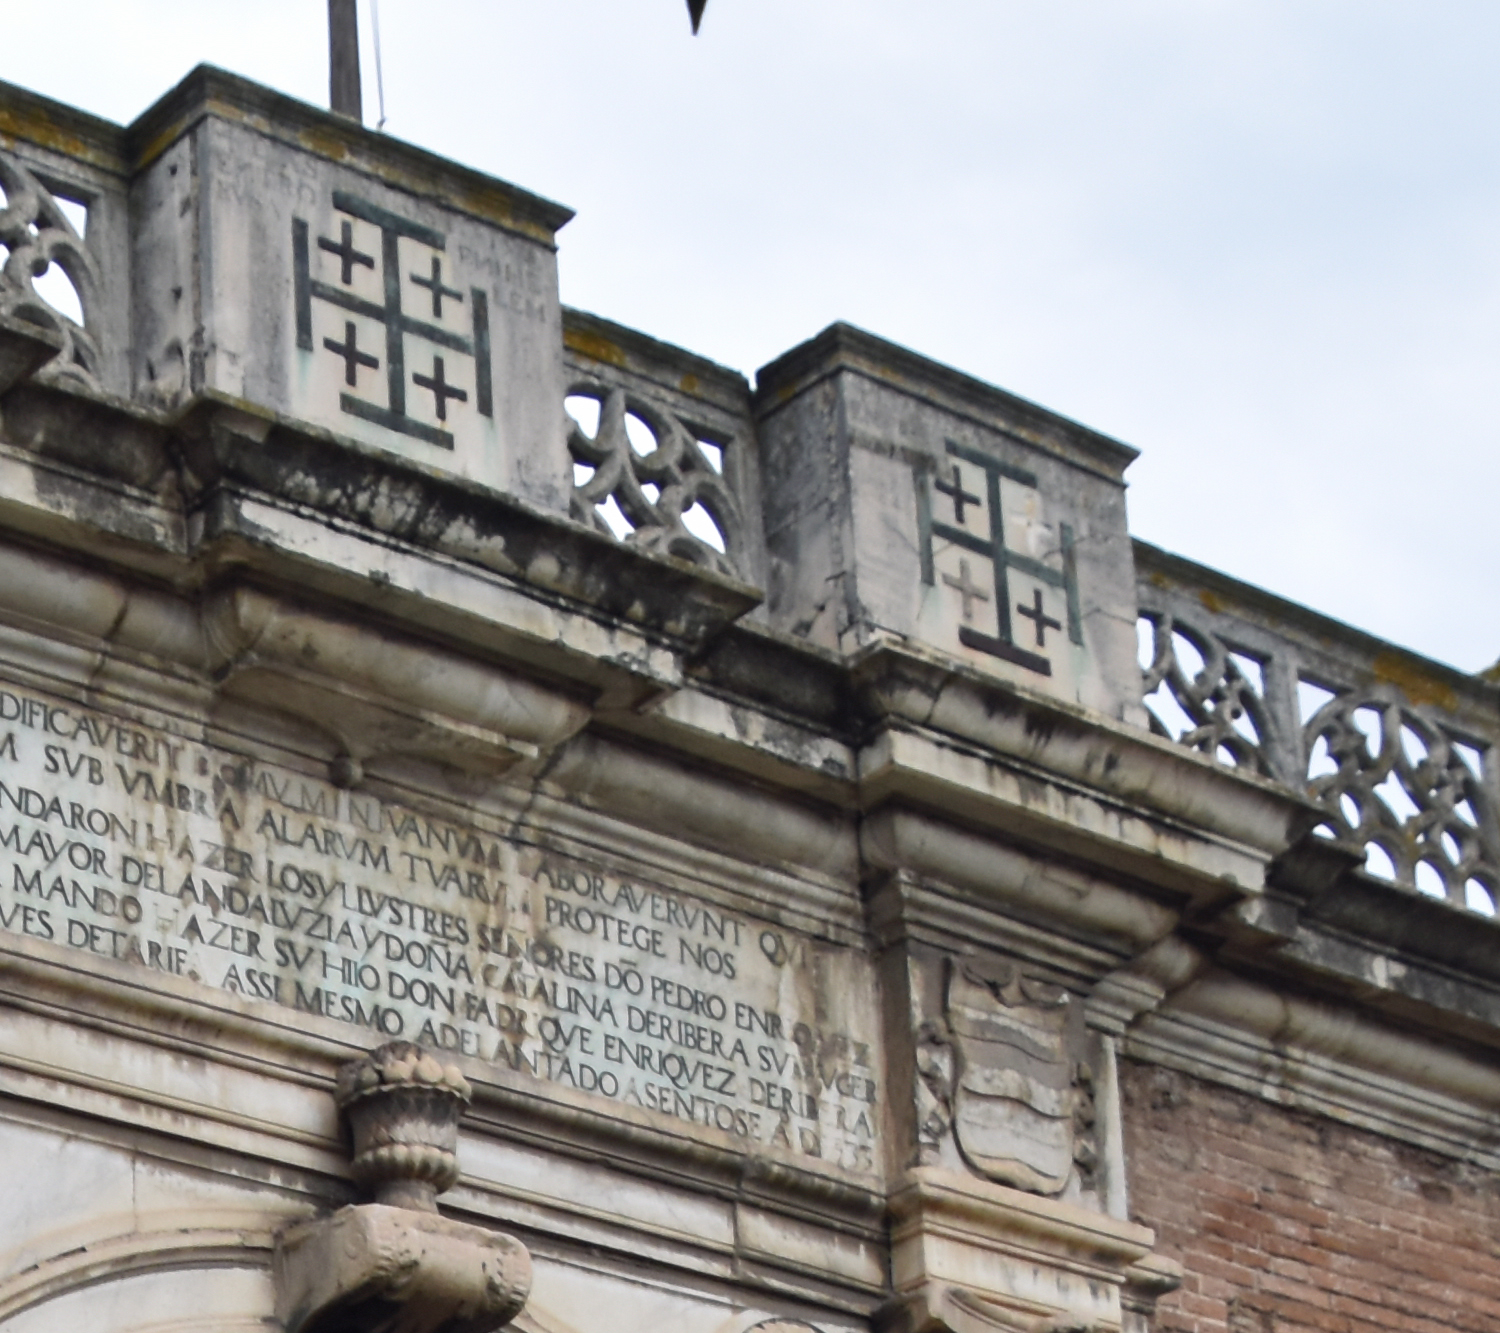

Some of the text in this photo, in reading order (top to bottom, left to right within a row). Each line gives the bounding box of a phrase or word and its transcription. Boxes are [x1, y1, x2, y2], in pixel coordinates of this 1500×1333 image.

[44, 744, 104, 785] SVB
[114, 763, 242, 831] VMBRA
[256, 807, 392, 874] ALARVM
[545, 895, 667, 959] PROTEGE
[679, 937, 736, 980] NOS
[145, 822, 261, 884] HAZER
[650, 975, 727, 1022] PEDRO
[13, 863, 143, 925] MANDO
[153, 902, 267, 962] HAZER
[273, 937, 317, 971] SV
[387, 970, 456, 1017] DON
[603, 1033, 736, 1098] ENRIQVEZ
[221, 963, 280, 1004] ASSI
[294, 978, 404, 1036] MESMO
[416, 1017, 620, 1099] ADELANTADO
[481, 960, 620, 1028] CATALINA
